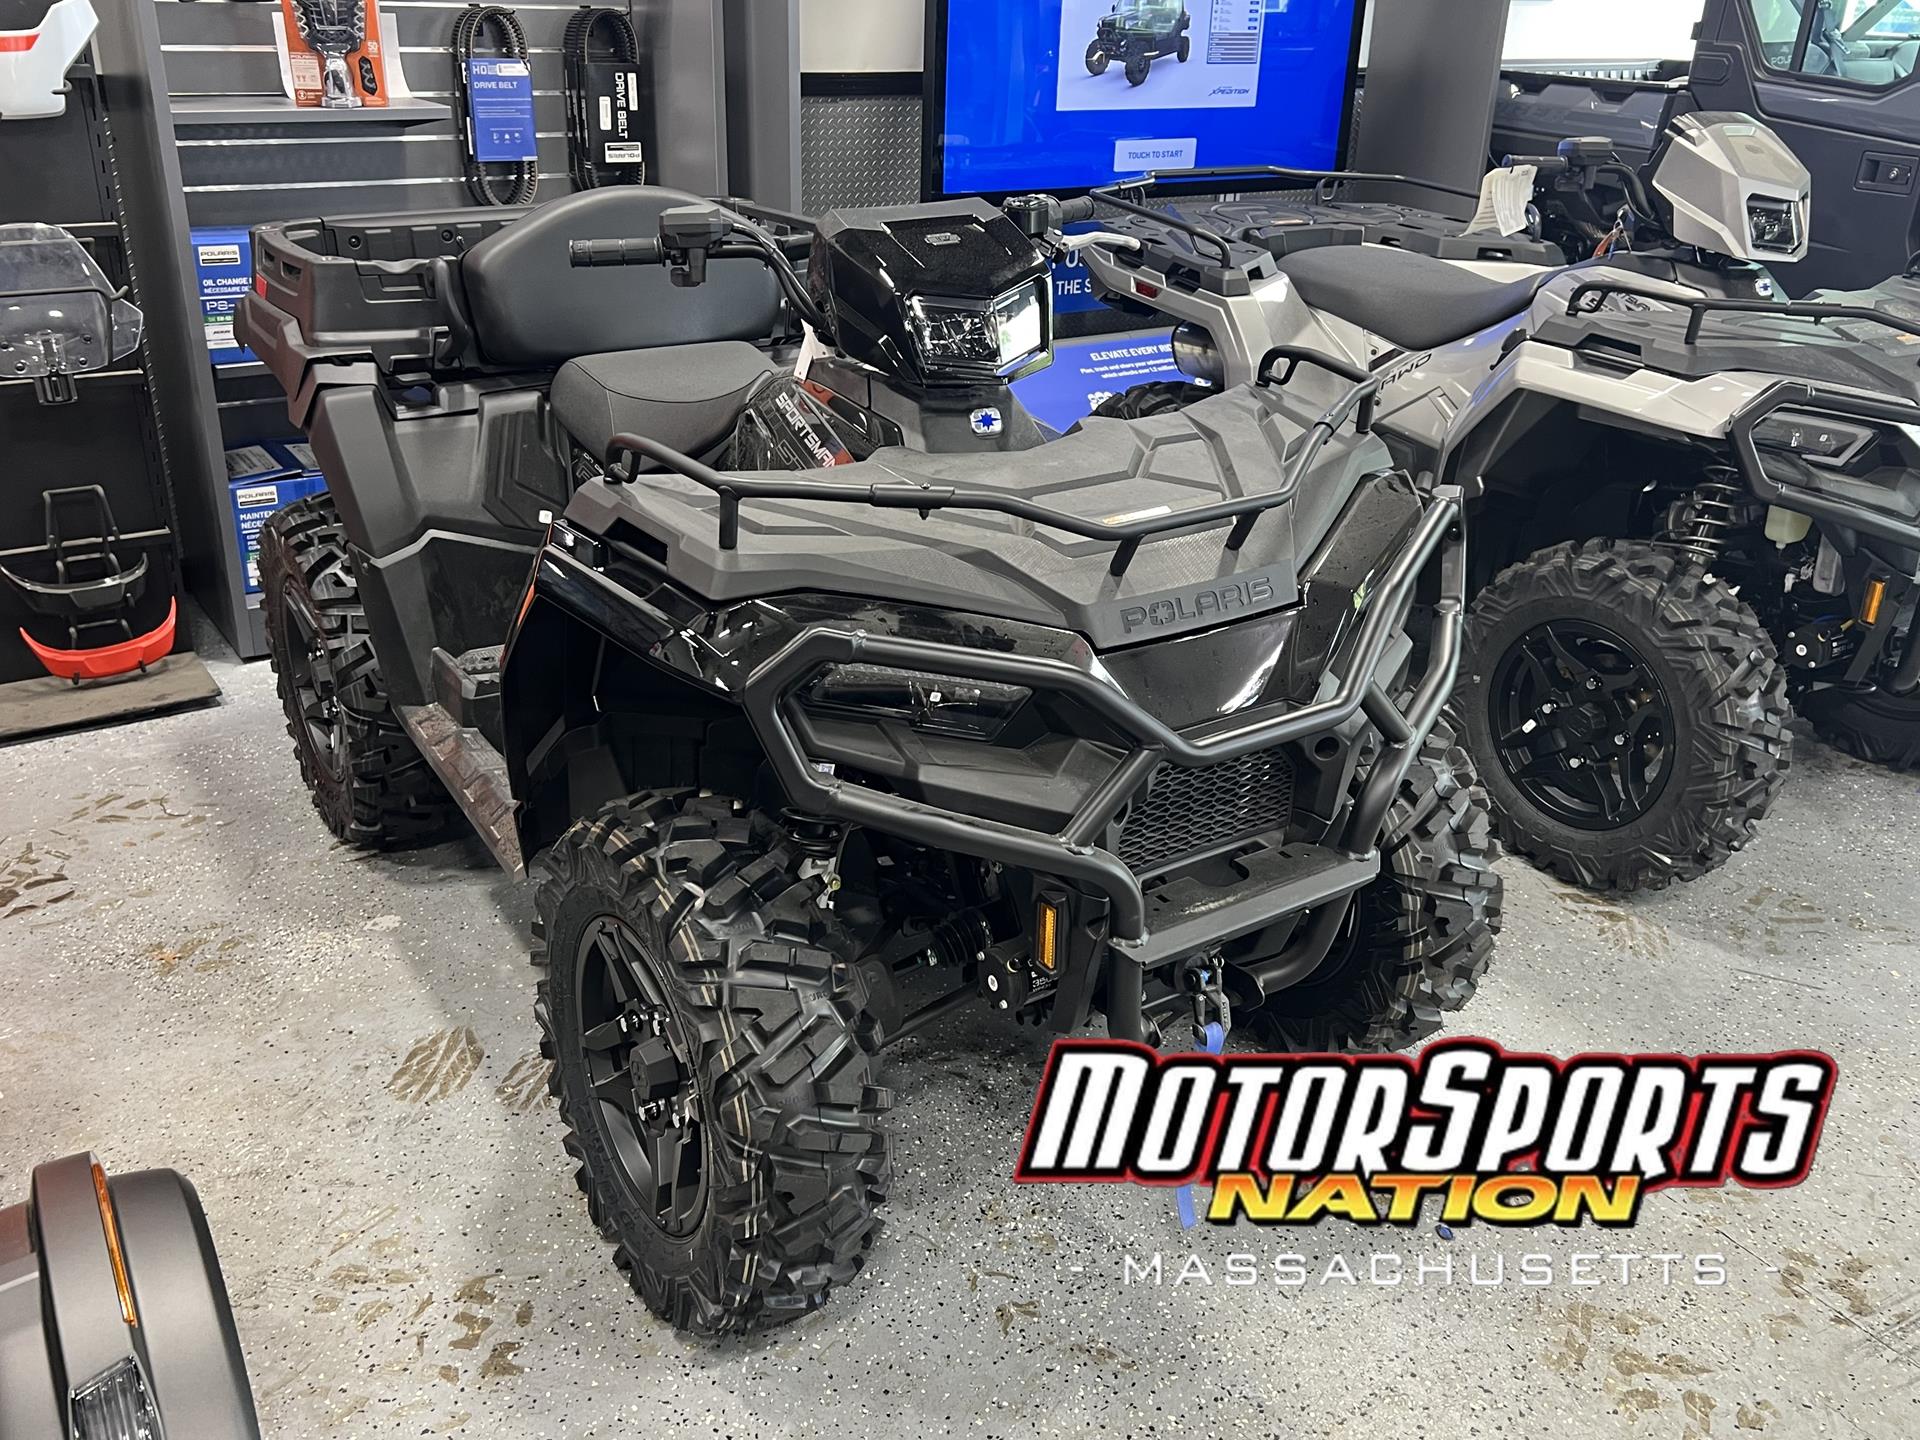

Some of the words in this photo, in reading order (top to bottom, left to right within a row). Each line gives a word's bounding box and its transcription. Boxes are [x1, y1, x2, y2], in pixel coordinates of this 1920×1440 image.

[474, 81, 497, 89] DRIVE
[615, 72, 627, 108] DRIVE
[617, 110, 628, 139] BELT
[1128, 151, 1151, 160] TOUCH
[1152, 151, 1161, 159] TO
[1161, 150, 1184, 158] START
[203, 279, 216, 287] OIL
[216, 277, 248, 286] CHANGE
[1056, 279, 1082, 295] THE
[1090, 349, 1130, 361] ELEVATE
[1130, 346, 1159, 357] EVERY
[1380, 353, 1432, 391] AWD
[239, 492, 275, 500] POLARIS
[1119, 577, 1274, 634] POLARIS
